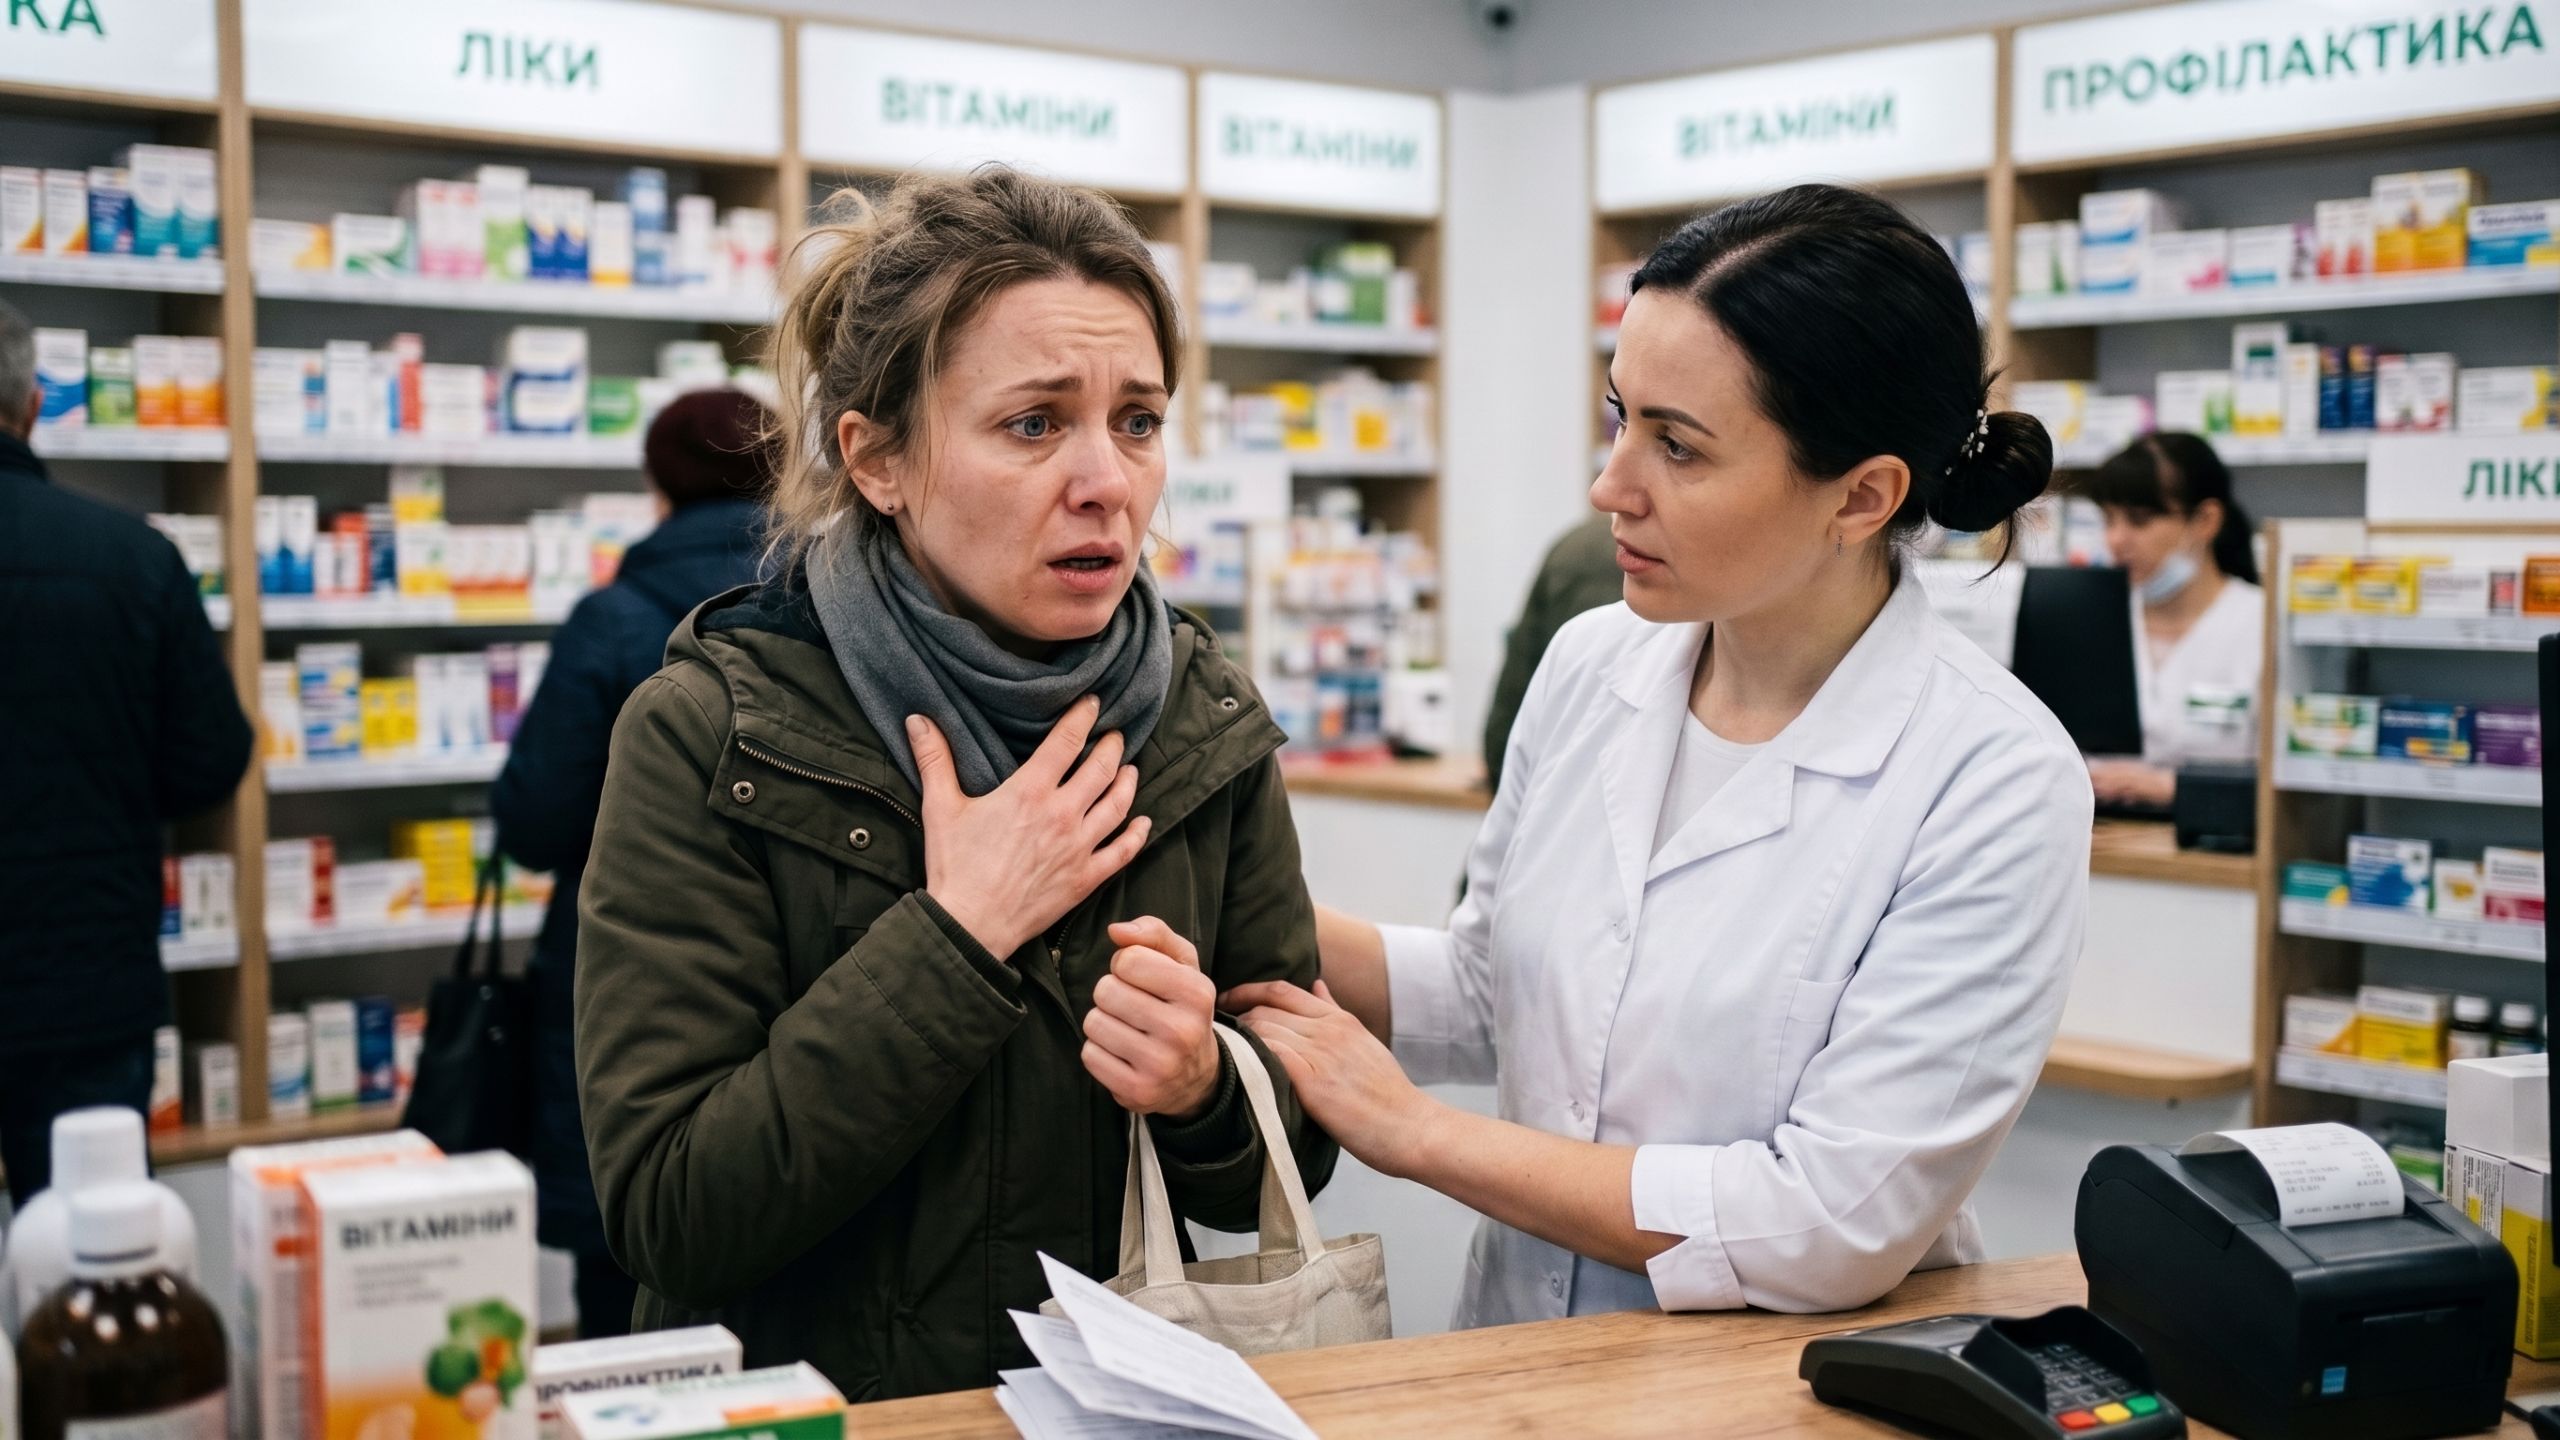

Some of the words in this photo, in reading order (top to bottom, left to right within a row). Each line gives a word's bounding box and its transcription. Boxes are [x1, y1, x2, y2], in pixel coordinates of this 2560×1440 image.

[457, 32, 598, 86] ЛІКИ
[2045, 4, 2543, 107] ПРОФІЛАКТИКА
[881, 80, 1112, 136] ВІТАМІНИ
[1680, 94, 1895, 157] ВІТАМІНИ
[1224, 118, 1416, 168] ВІТАМІНИ
[2463, 458, 2560, 497] ЛІК
[340, 1207, 515, 1250] ВІТАМІНИ
